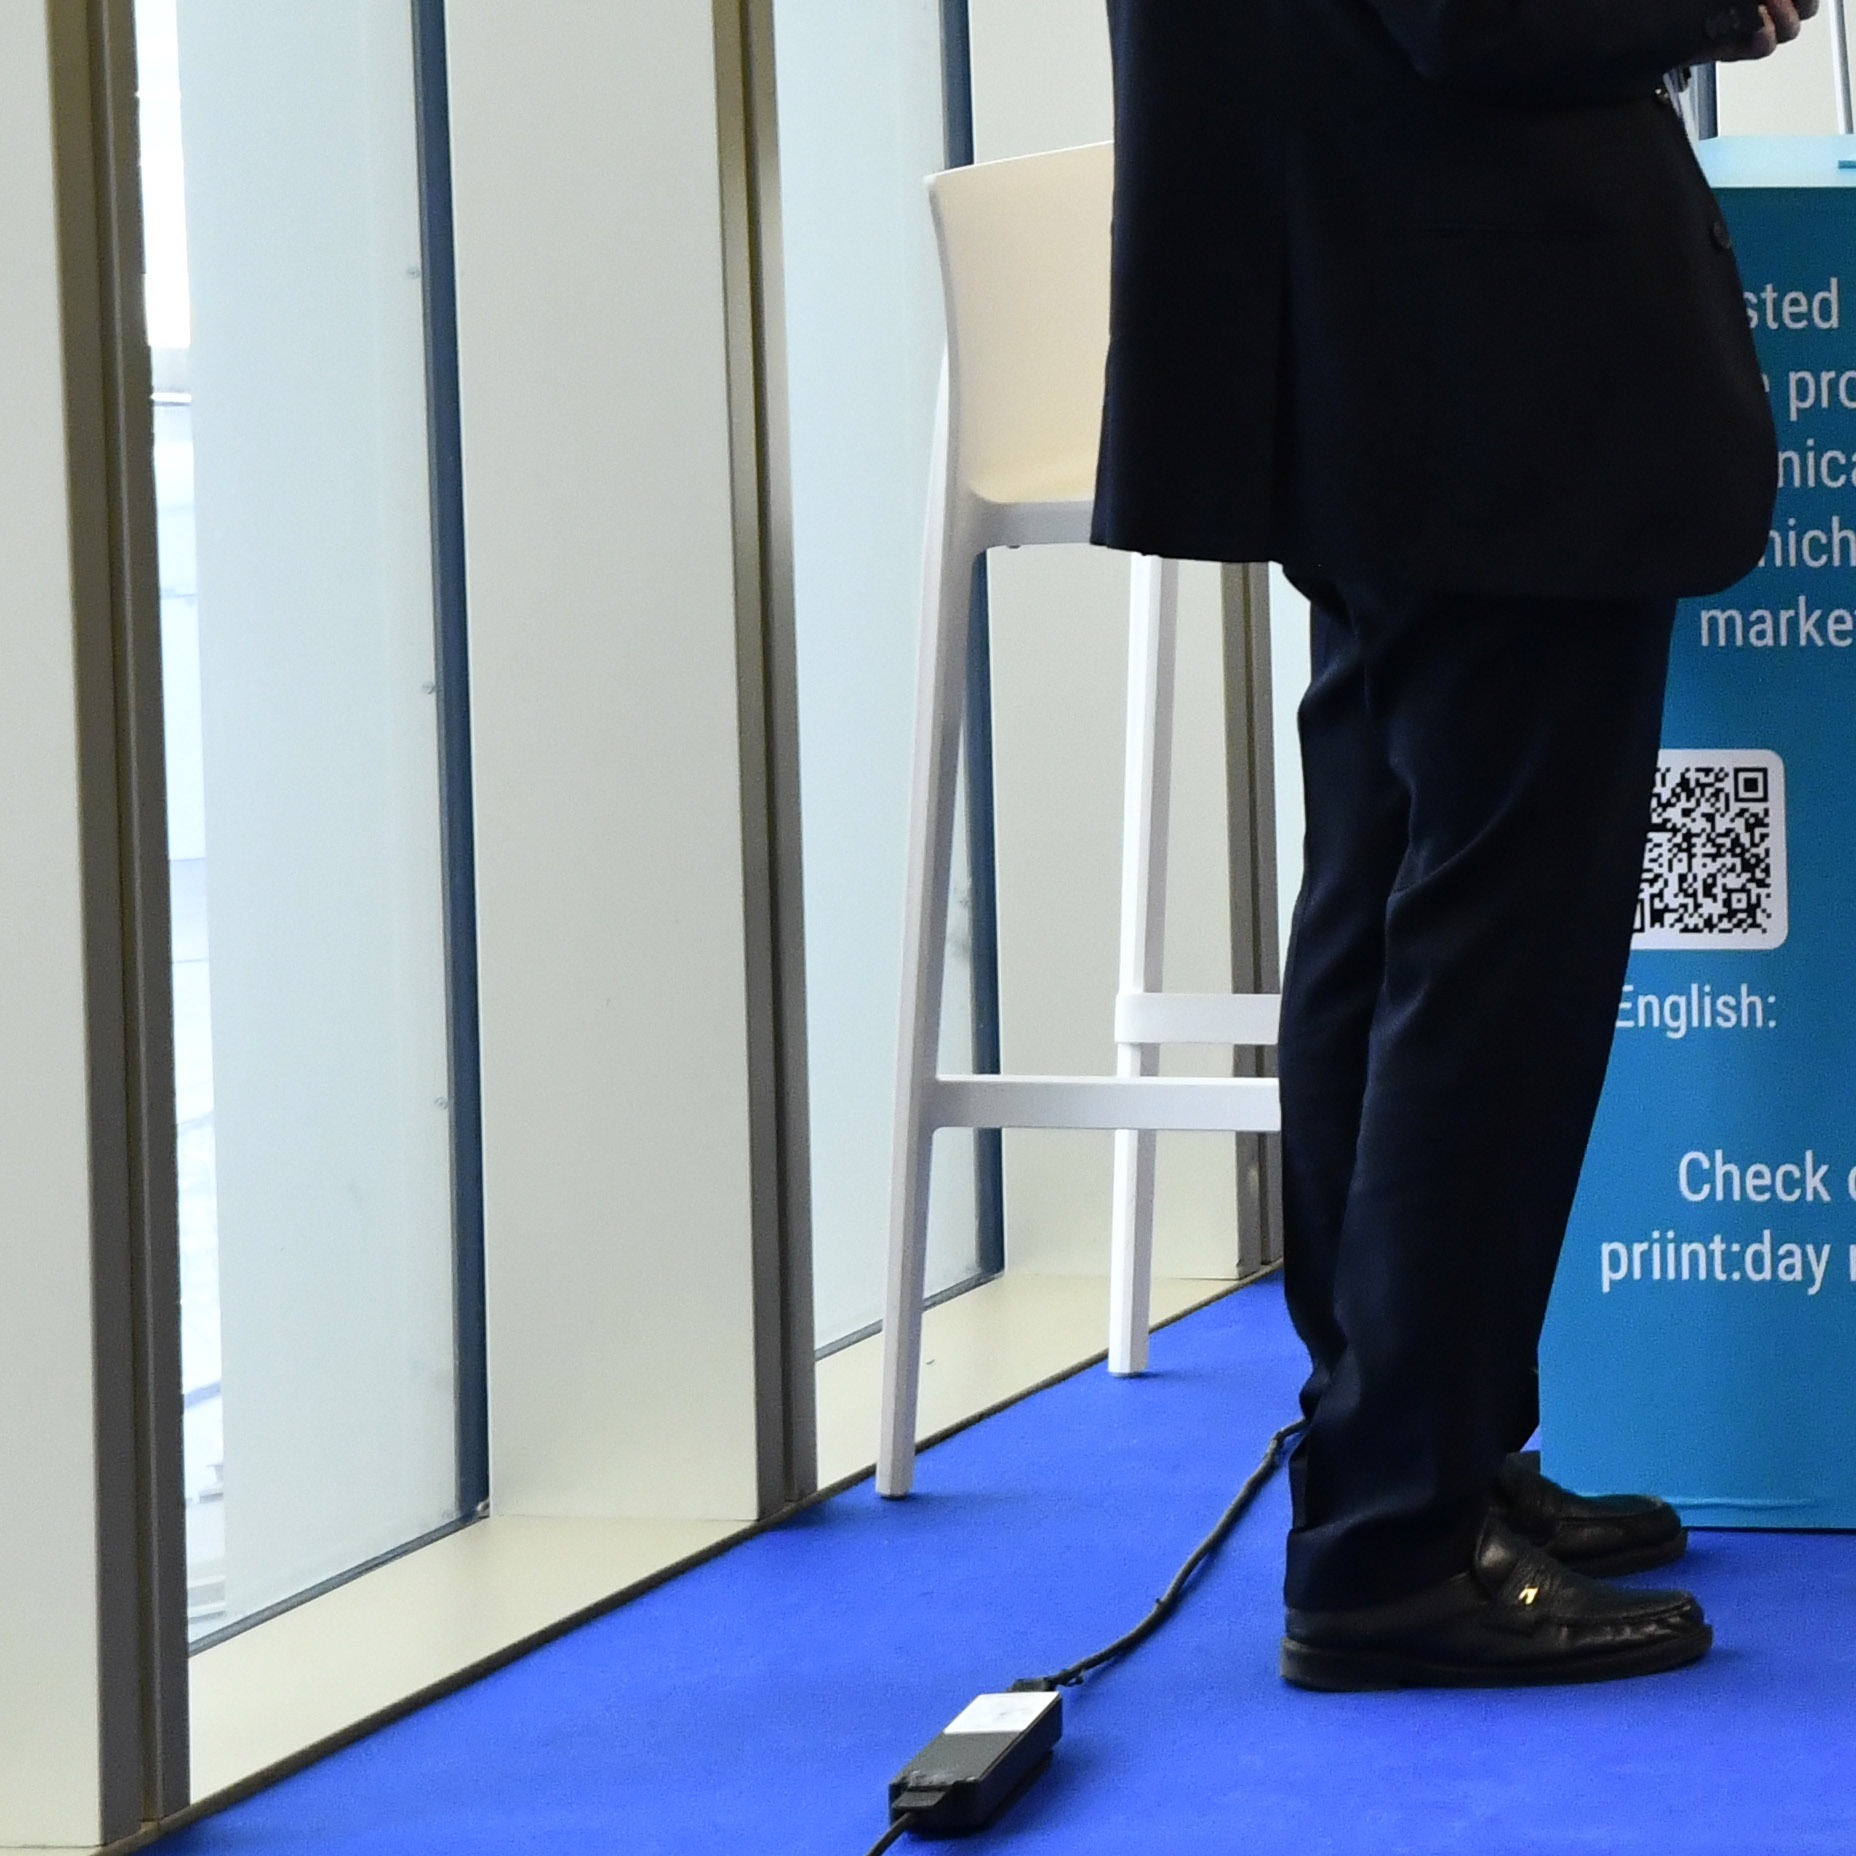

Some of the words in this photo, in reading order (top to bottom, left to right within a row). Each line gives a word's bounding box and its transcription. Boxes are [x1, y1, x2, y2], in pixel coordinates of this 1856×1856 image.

[1743, 276, 1840, 330] sted
[1677, 1148, 1832, 1204] Check
[1600, 1228, 1833, 1297] priint:day
